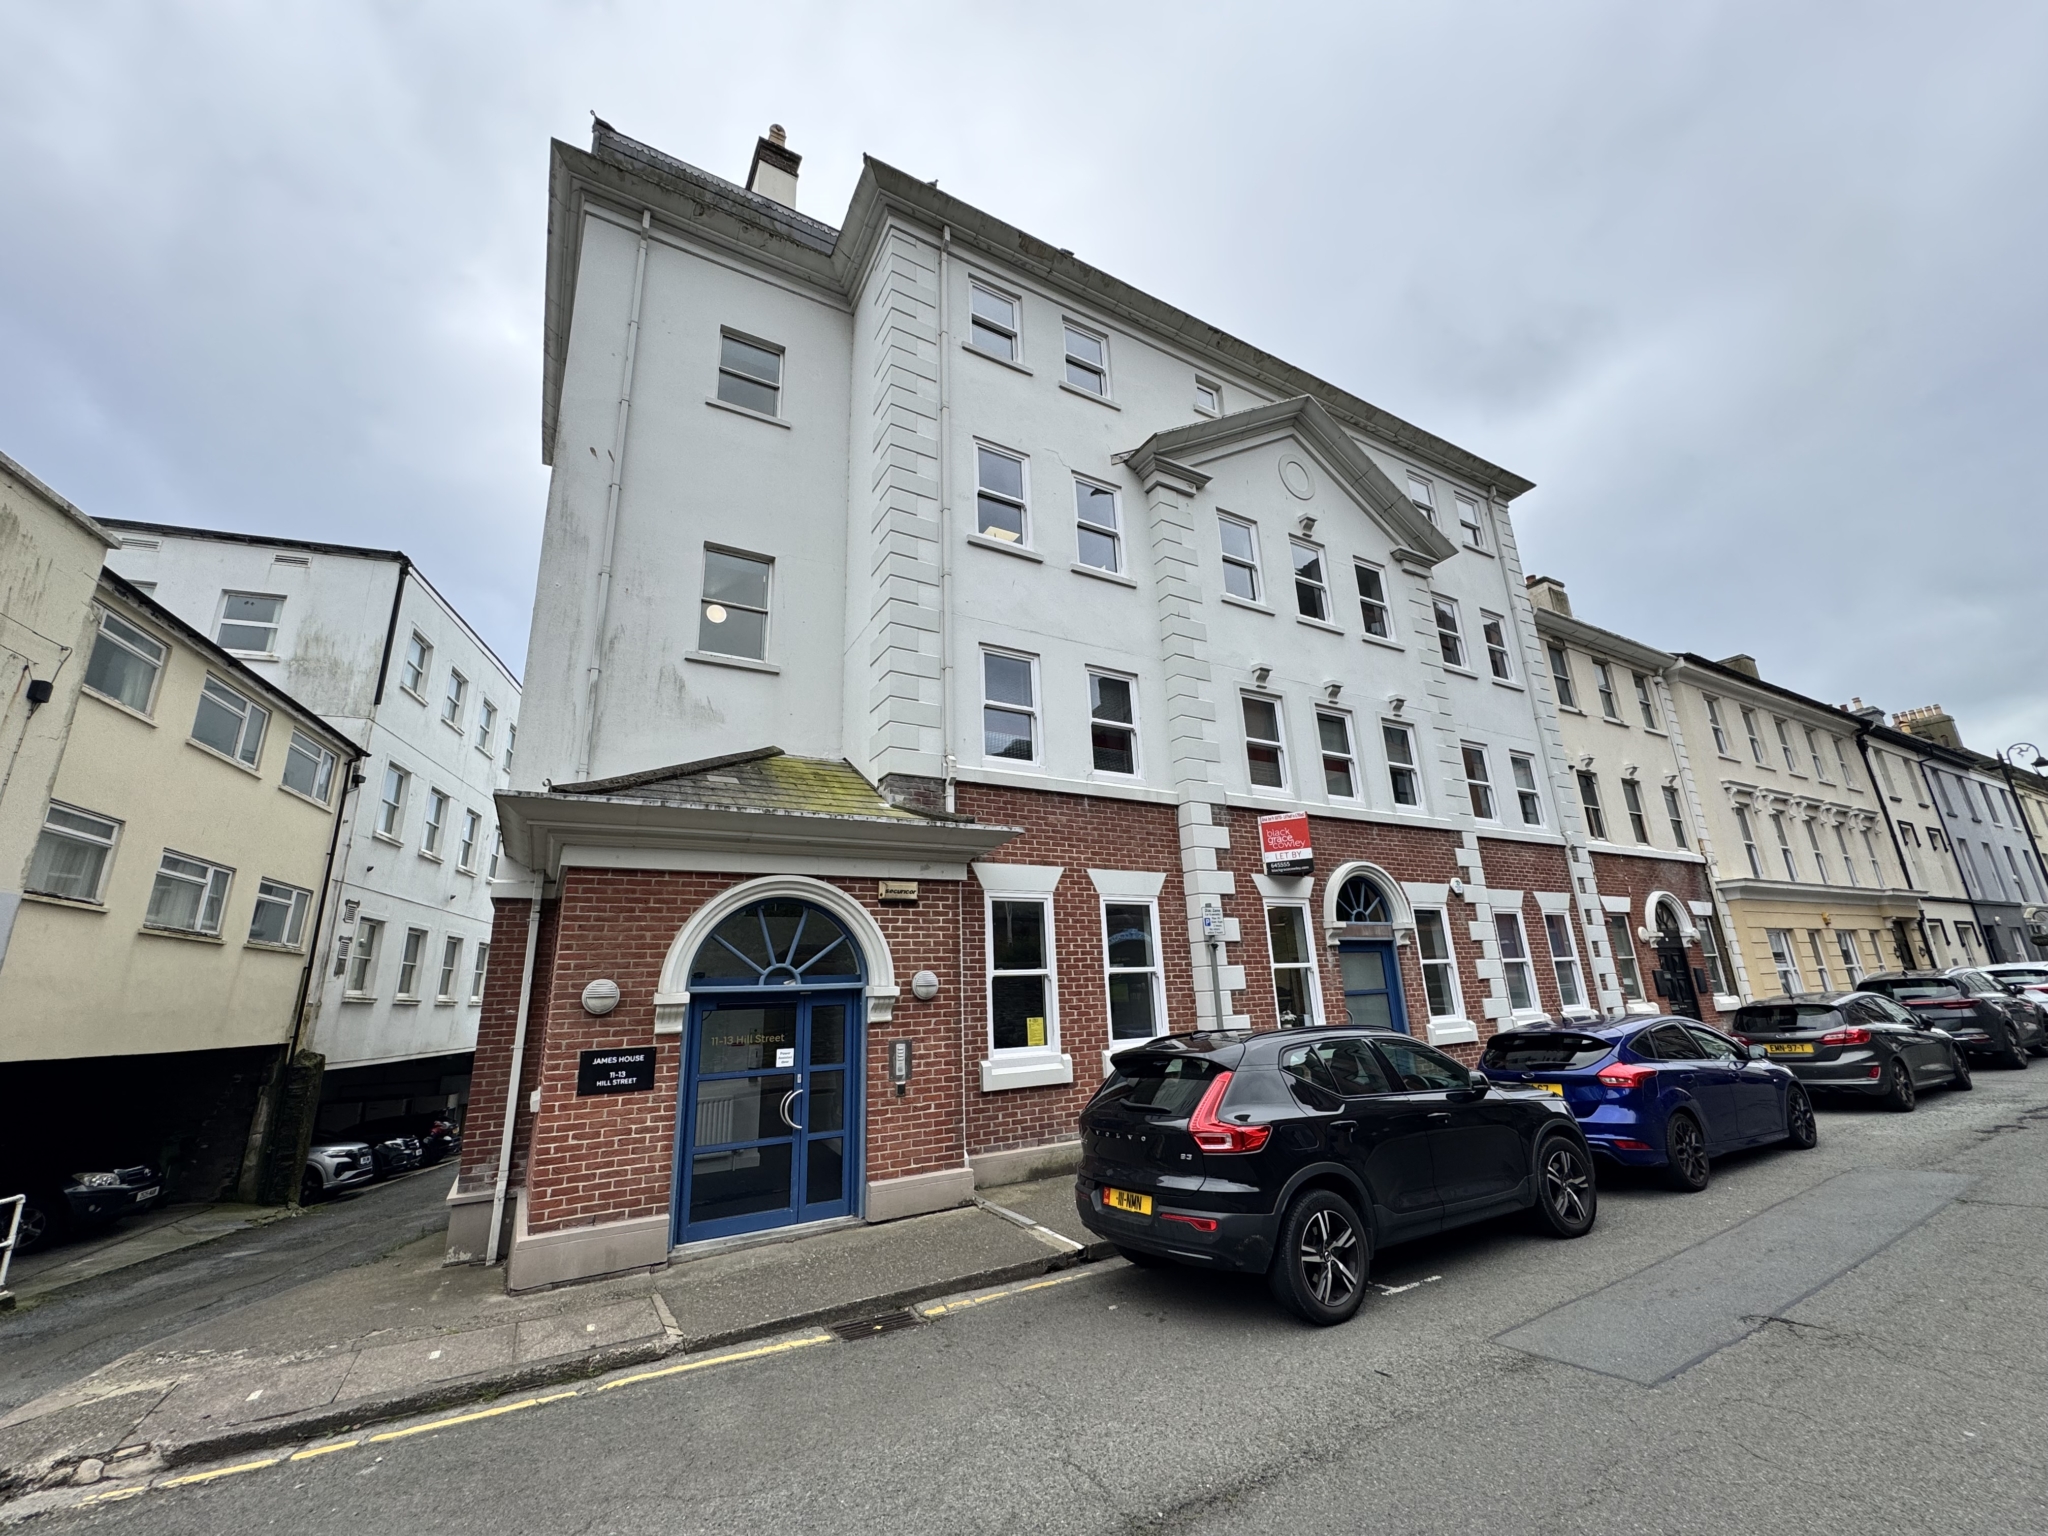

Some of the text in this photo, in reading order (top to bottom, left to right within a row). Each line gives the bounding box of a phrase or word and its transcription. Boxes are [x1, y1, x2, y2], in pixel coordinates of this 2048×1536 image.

[1266, 827, 1290, 837] black
[1267, 834, 1293, 846] grace
[1272, 839, 1306, 850] cowley
[1275, 851, 1302, 860] LET BY
[711, 1033, 785, 1046] 11-13 Hill Street
[592, 1054, 645, 1065] JAMES HOUSE
[609, 1070, 626, 1079] 11-13
[612, 1077, 637, 1086] STREET
[1095, 1130, 1147, 1142] VOLVO
